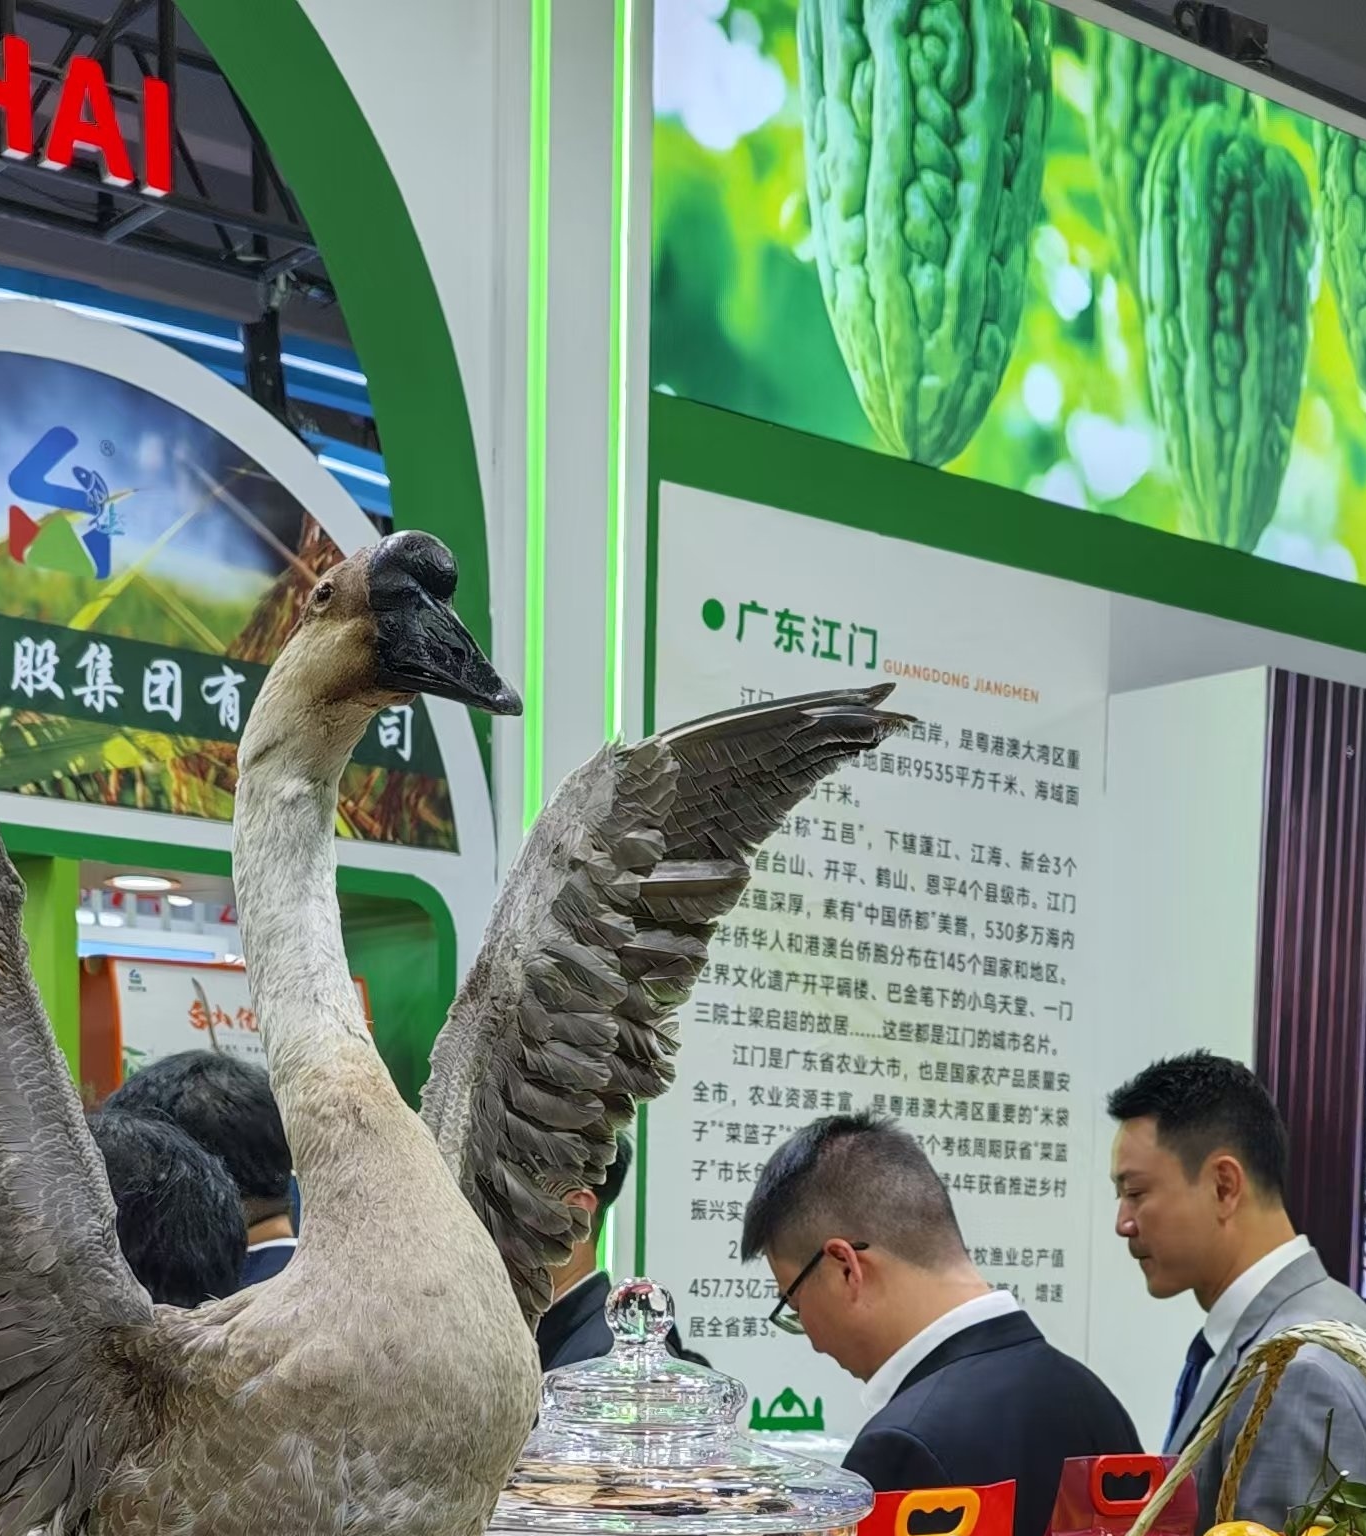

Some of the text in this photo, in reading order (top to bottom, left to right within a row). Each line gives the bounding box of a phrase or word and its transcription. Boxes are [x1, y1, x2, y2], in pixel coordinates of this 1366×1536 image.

[736, 601, 878, 670] 广东江门
[883, 659, 1040, 705] GUANGDONG JIANGMEN
[377, 706, 417, 763] 司
